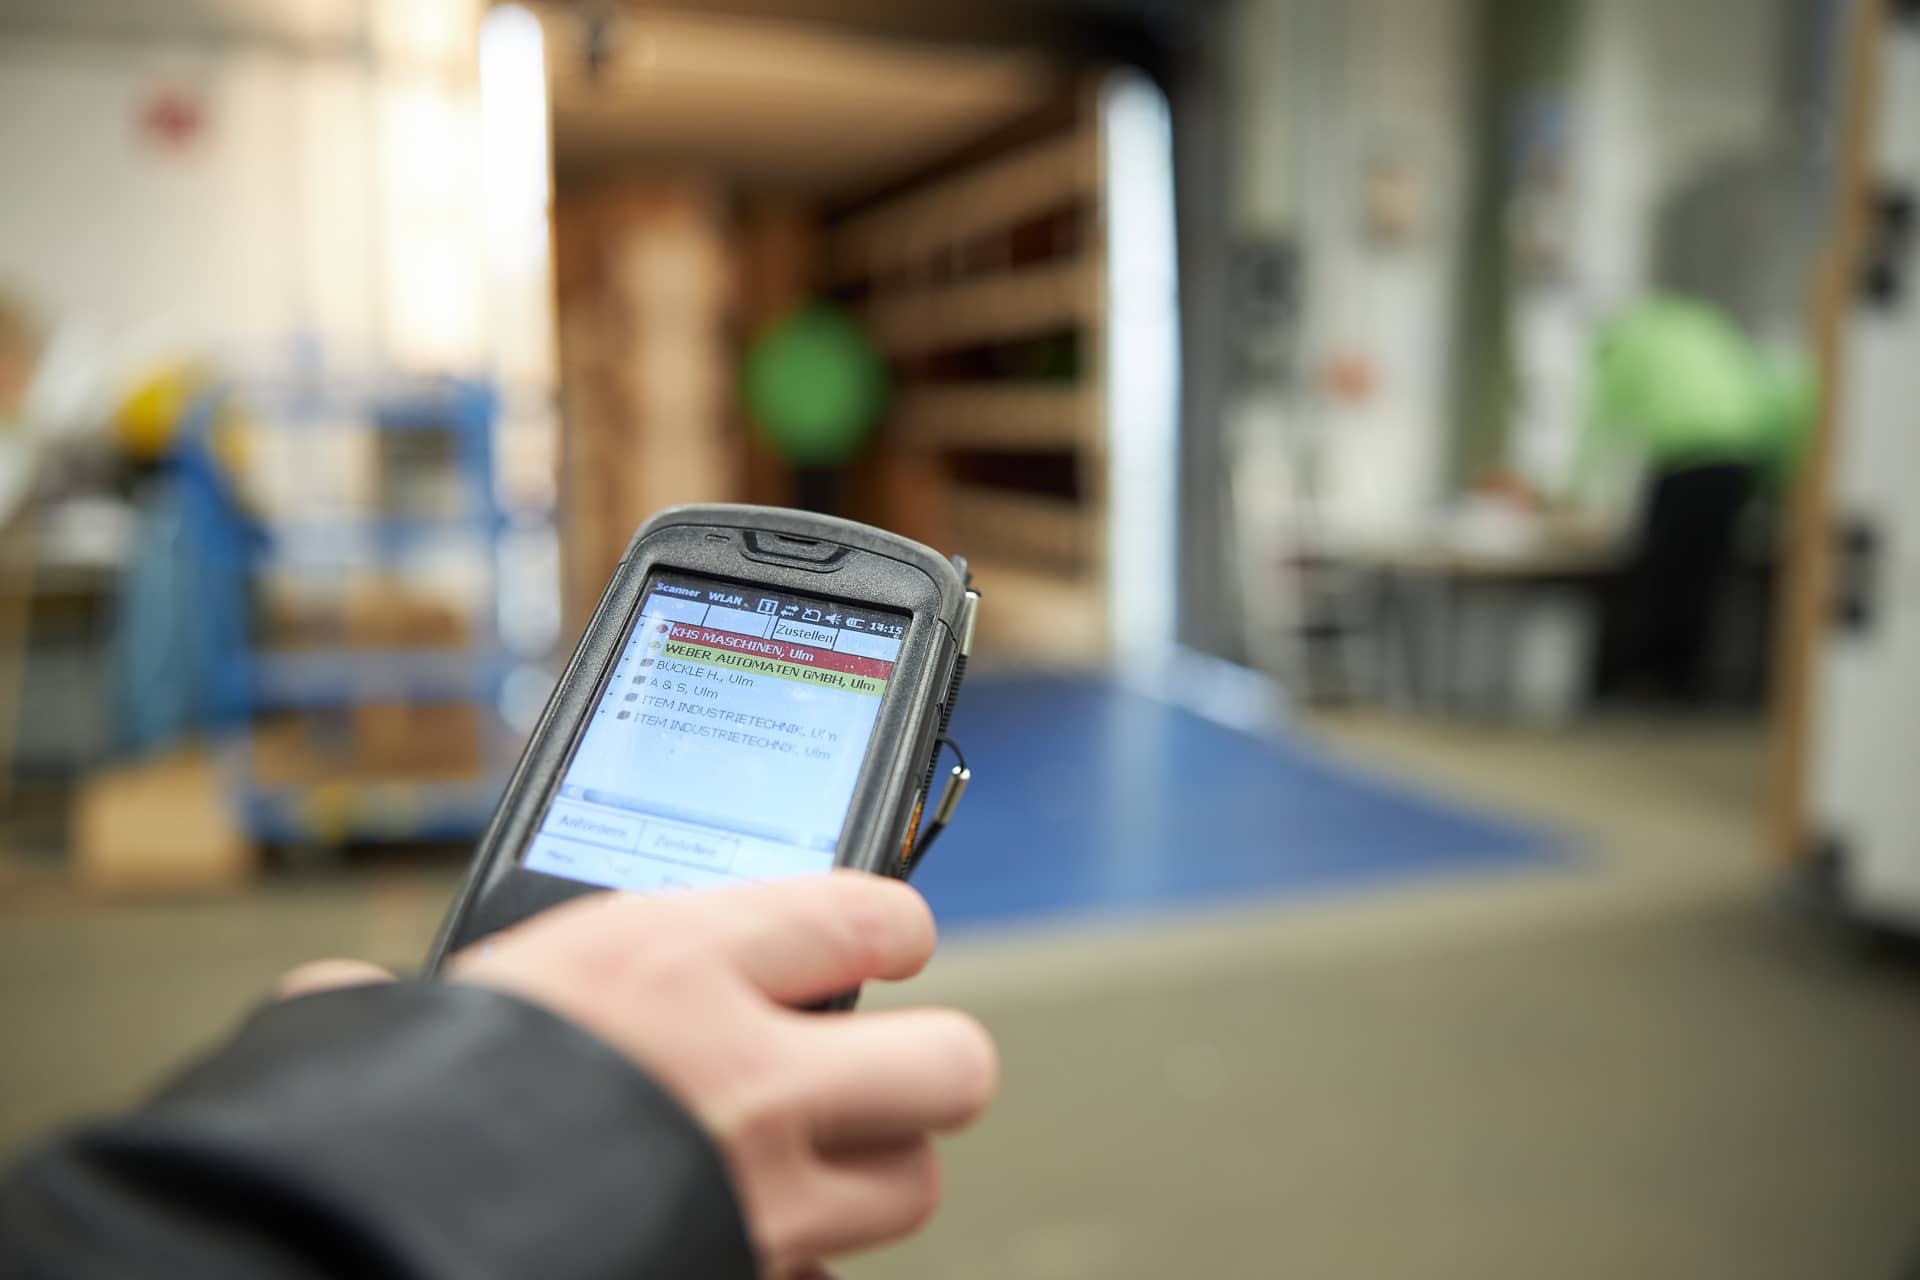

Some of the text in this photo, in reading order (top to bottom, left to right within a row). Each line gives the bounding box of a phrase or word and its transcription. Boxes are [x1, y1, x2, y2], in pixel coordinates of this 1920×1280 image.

[655, 582, 701, 598] Scanner
[709, 591, 742, 606] WLAN
[775, 623, 833, 644] Zustellen
[869, 621, 903, 635] 14:15
[671, 625, 814, 662] KHS MASCHINEN, Ulm
[665, 644, 876, 692] WEBER AUTOMATEN GMBH, Ulm
[650, 678, 719, 700] A & S, Ulm
[729, 674, 754, 688] Ulm
[641, 695, 675, 710] ITEM
[633, 713, 667, 729] ITEM
[805, 745, 832, 760] Ulm
